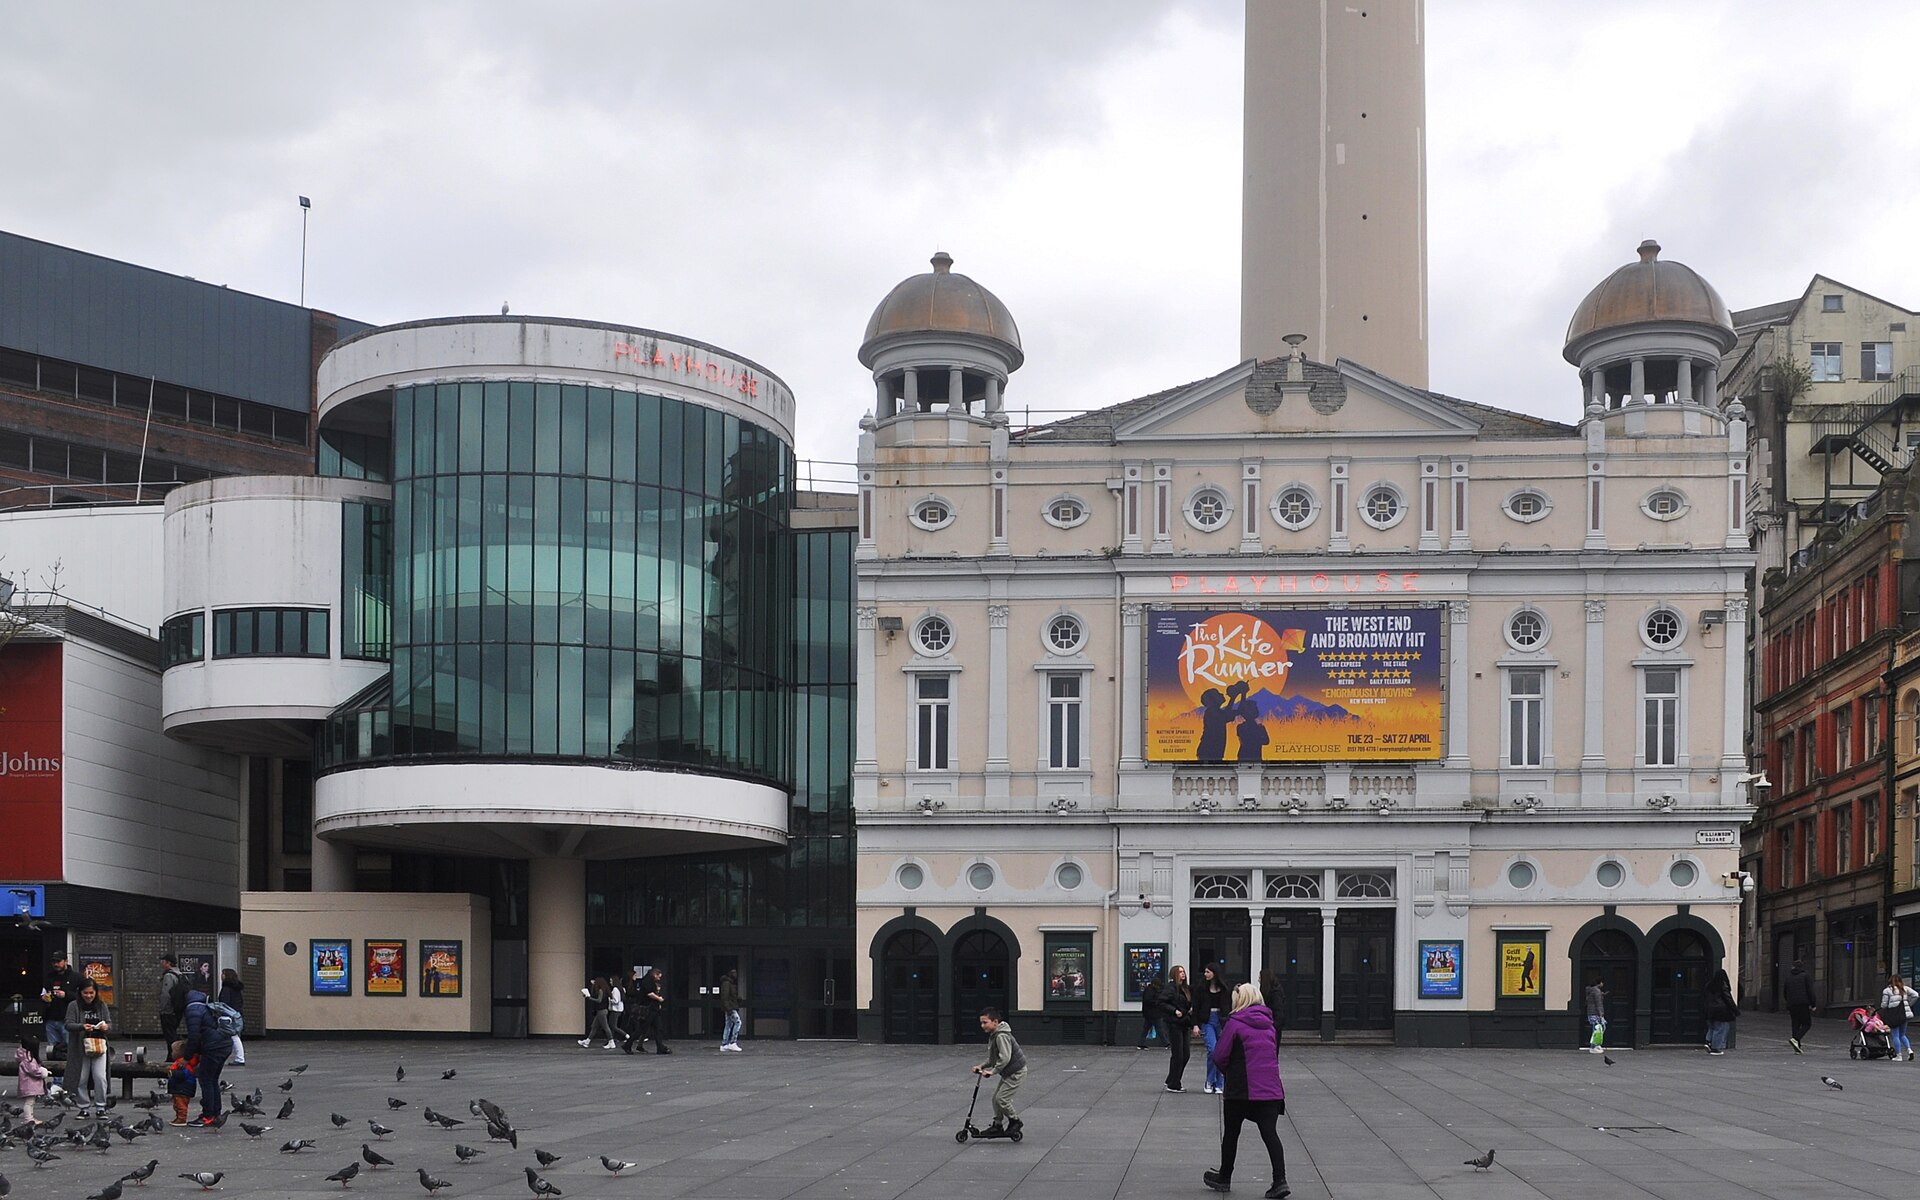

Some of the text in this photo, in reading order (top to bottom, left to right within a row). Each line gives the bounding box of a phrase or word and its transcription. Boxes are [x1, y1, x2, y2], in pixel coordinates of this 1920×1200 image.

[614, 342, 759, 398] PLAYHOUSE
[1172, 573, 1419, 593] PLAYHOUSE
[1325, 616, 1411, 632] THE WEST END
[1188, 620, 1274, 660] The Kite
[1311, 632, 1426, 648] AND BROADWAY HIT
[1178, 634, 1293, 686] Runner
[1275, 744, 1341, 752] PLAYHOUSE
[1347, 734, 1362, 744] TUE
[1364, 734, 1374, 744] 23
[1382, 734, 1398, 744] SAT
[1398, 734, 1408, 744] 27
[1409, 734, 1432, 744] APRIL
